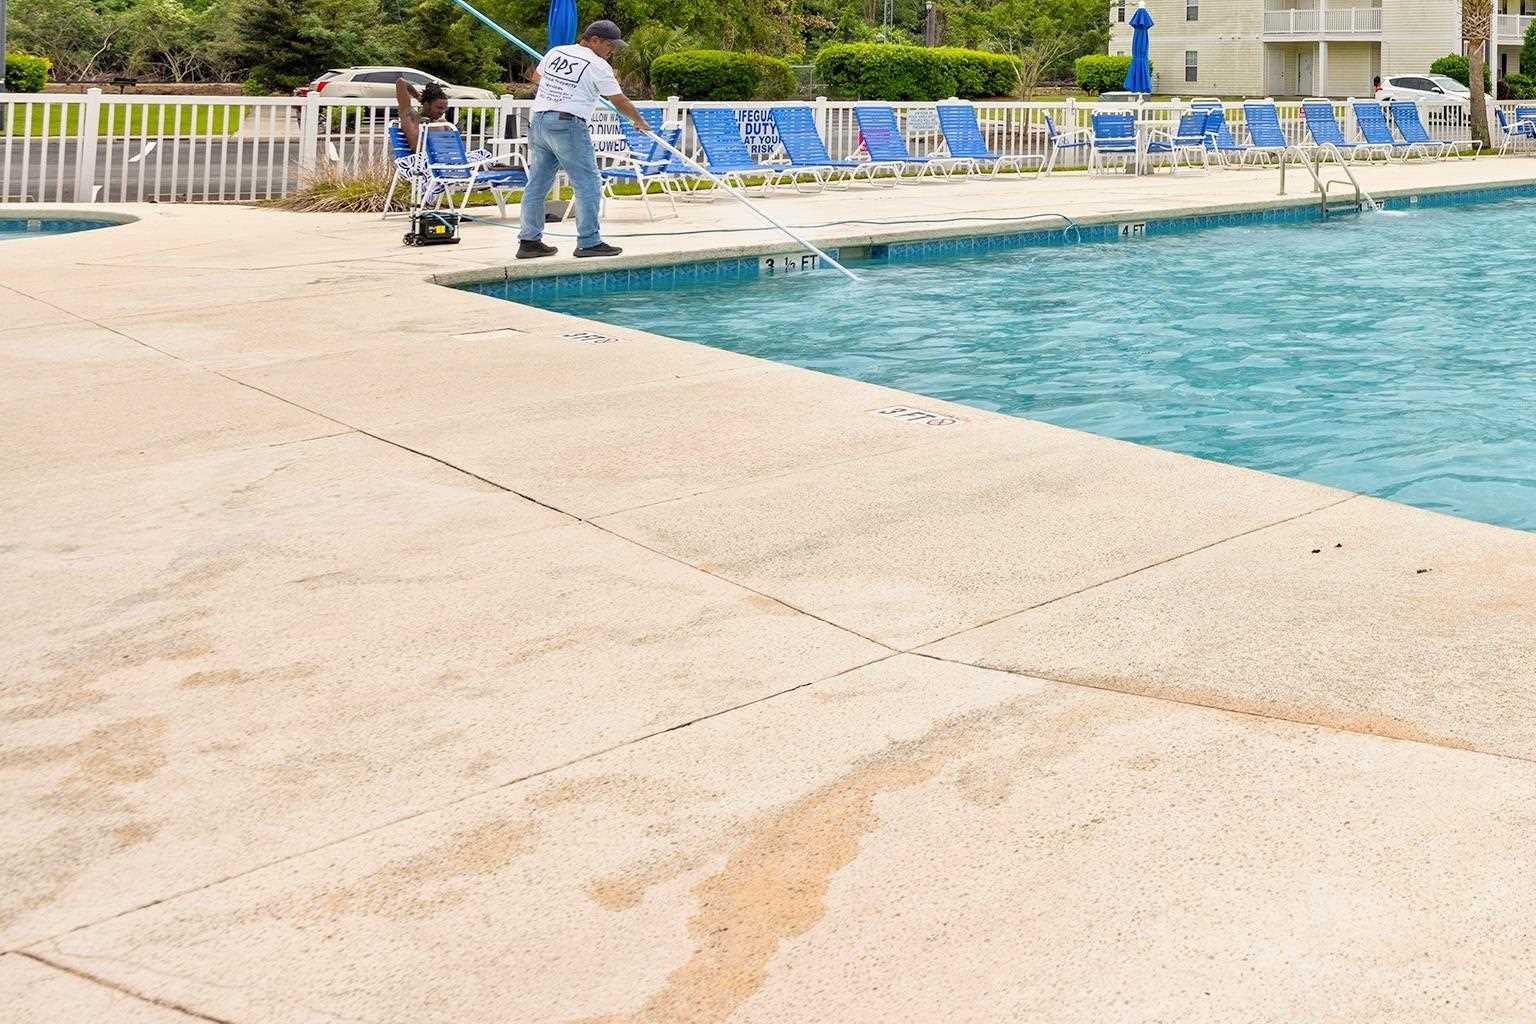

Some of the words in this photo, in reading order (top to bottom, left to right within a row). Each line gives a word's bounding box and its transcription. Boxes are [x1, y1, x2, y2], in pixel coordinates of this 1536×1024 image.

[549, 56, 579, 75] APS
[597, 124, 624, 135] DIVIN
[745, 123, 776, 135] DUTY
[744, 136, 755, 144] AT
[759, 136, 781, 144] YOU
[751, 145, 774, 153] RISK
[1122, 225, 1129, 236] 4
[1133, 224, 1144, 237] FT
[801, 255, 818, 271] FT
[894, 411, 937, 421] FT
